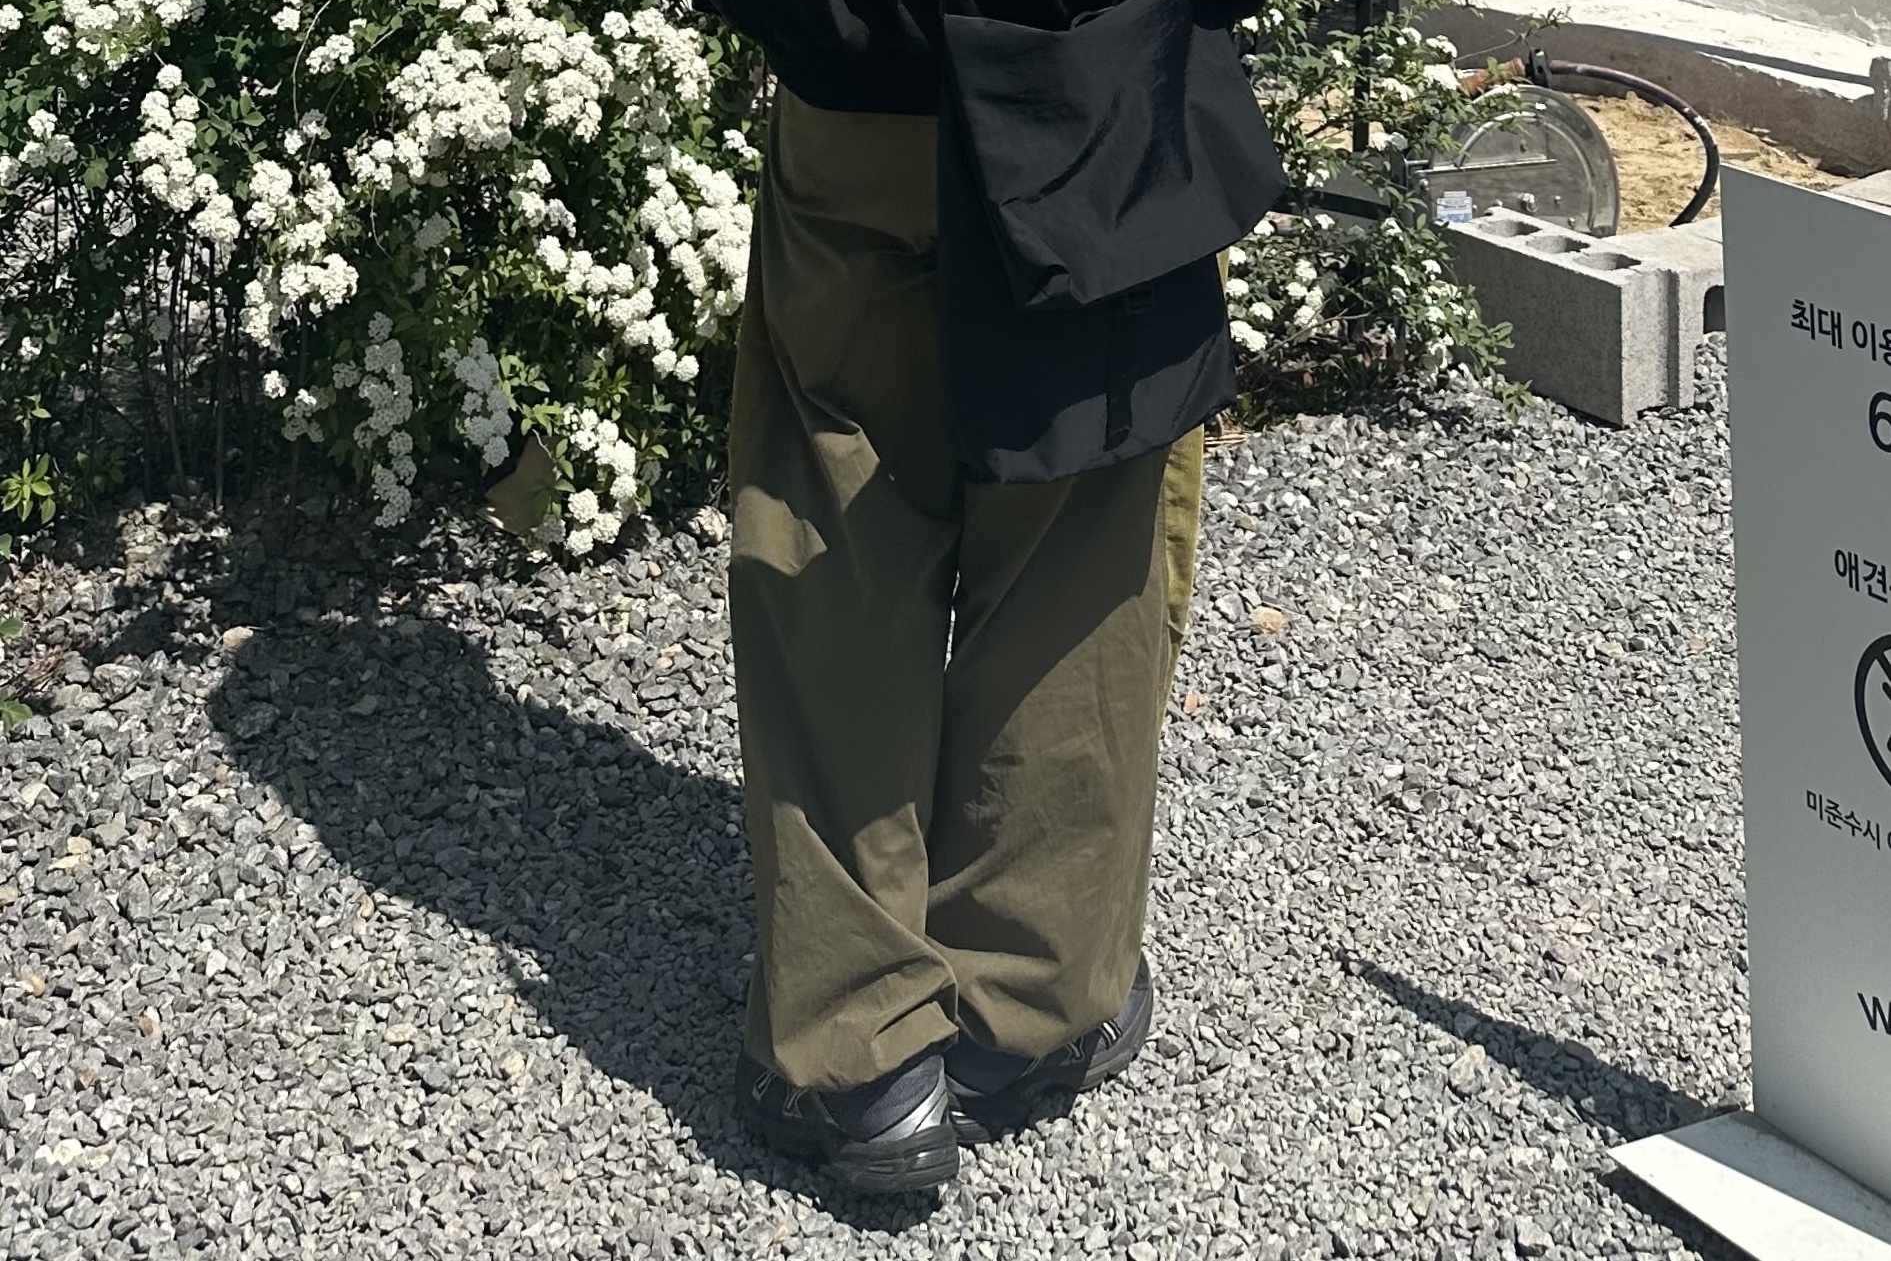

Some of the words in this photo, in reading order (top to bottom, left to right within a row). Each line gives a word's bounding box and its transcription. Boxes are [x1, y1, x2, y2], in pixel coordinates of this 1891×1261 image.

[1790, 298, 1843, 350] 최대
[1834, 548, 1891, 604] 애견
[1806, 789, 1881, 851] 미준수시
